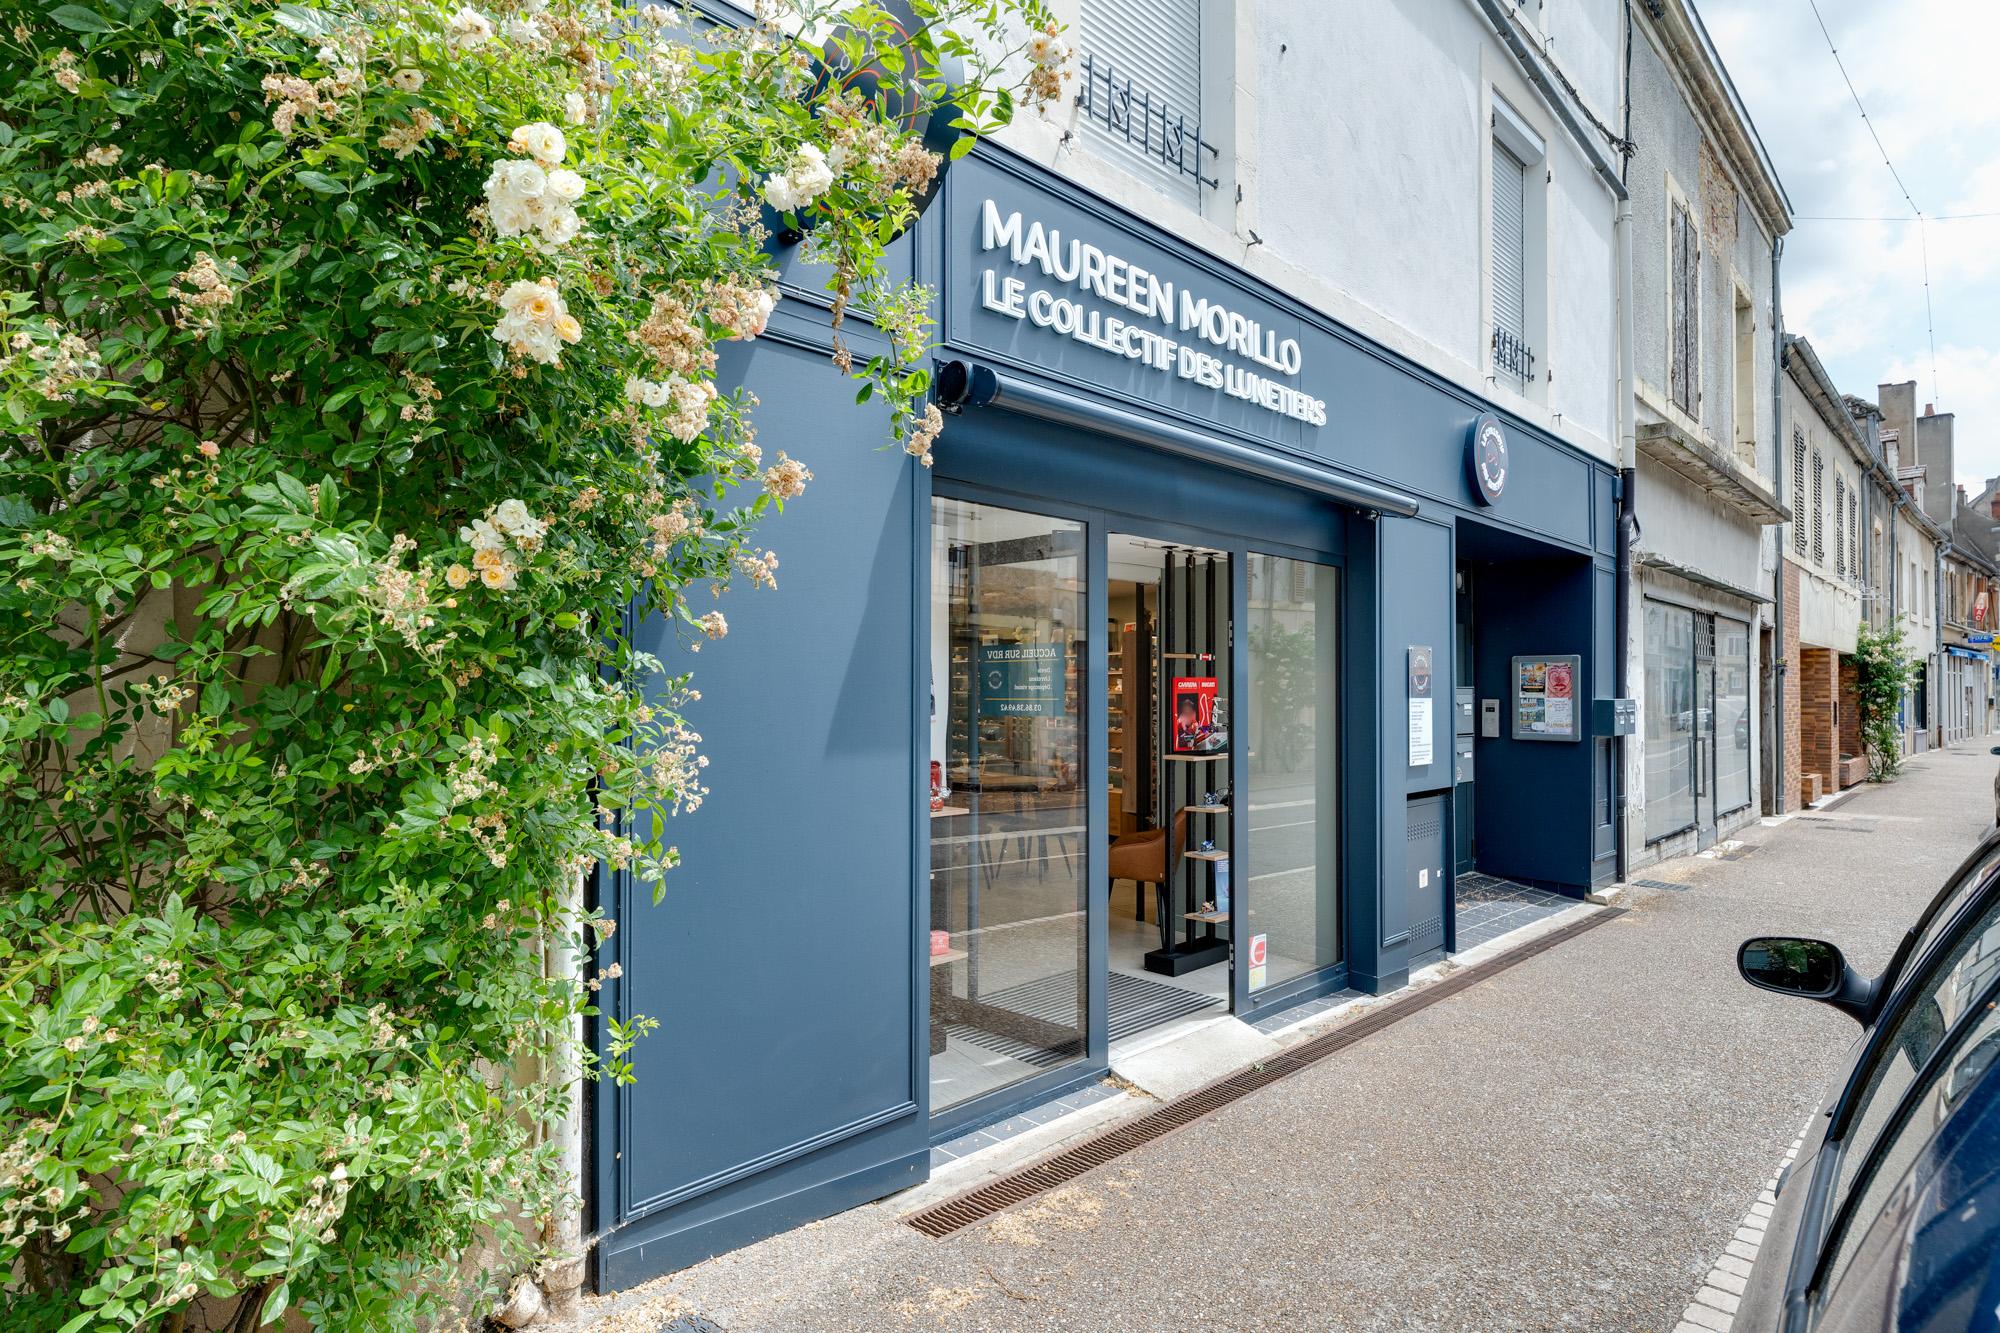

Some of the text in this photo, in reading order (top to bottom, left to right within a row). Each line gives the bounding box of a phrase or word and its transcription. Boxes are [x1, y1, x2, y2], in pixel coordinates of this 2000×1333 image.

[982, 199, 1302, 376] MAUREEN MORILLO
[982, 269, 1327, 427] LE COLLECTIF DES LUNETIERS
